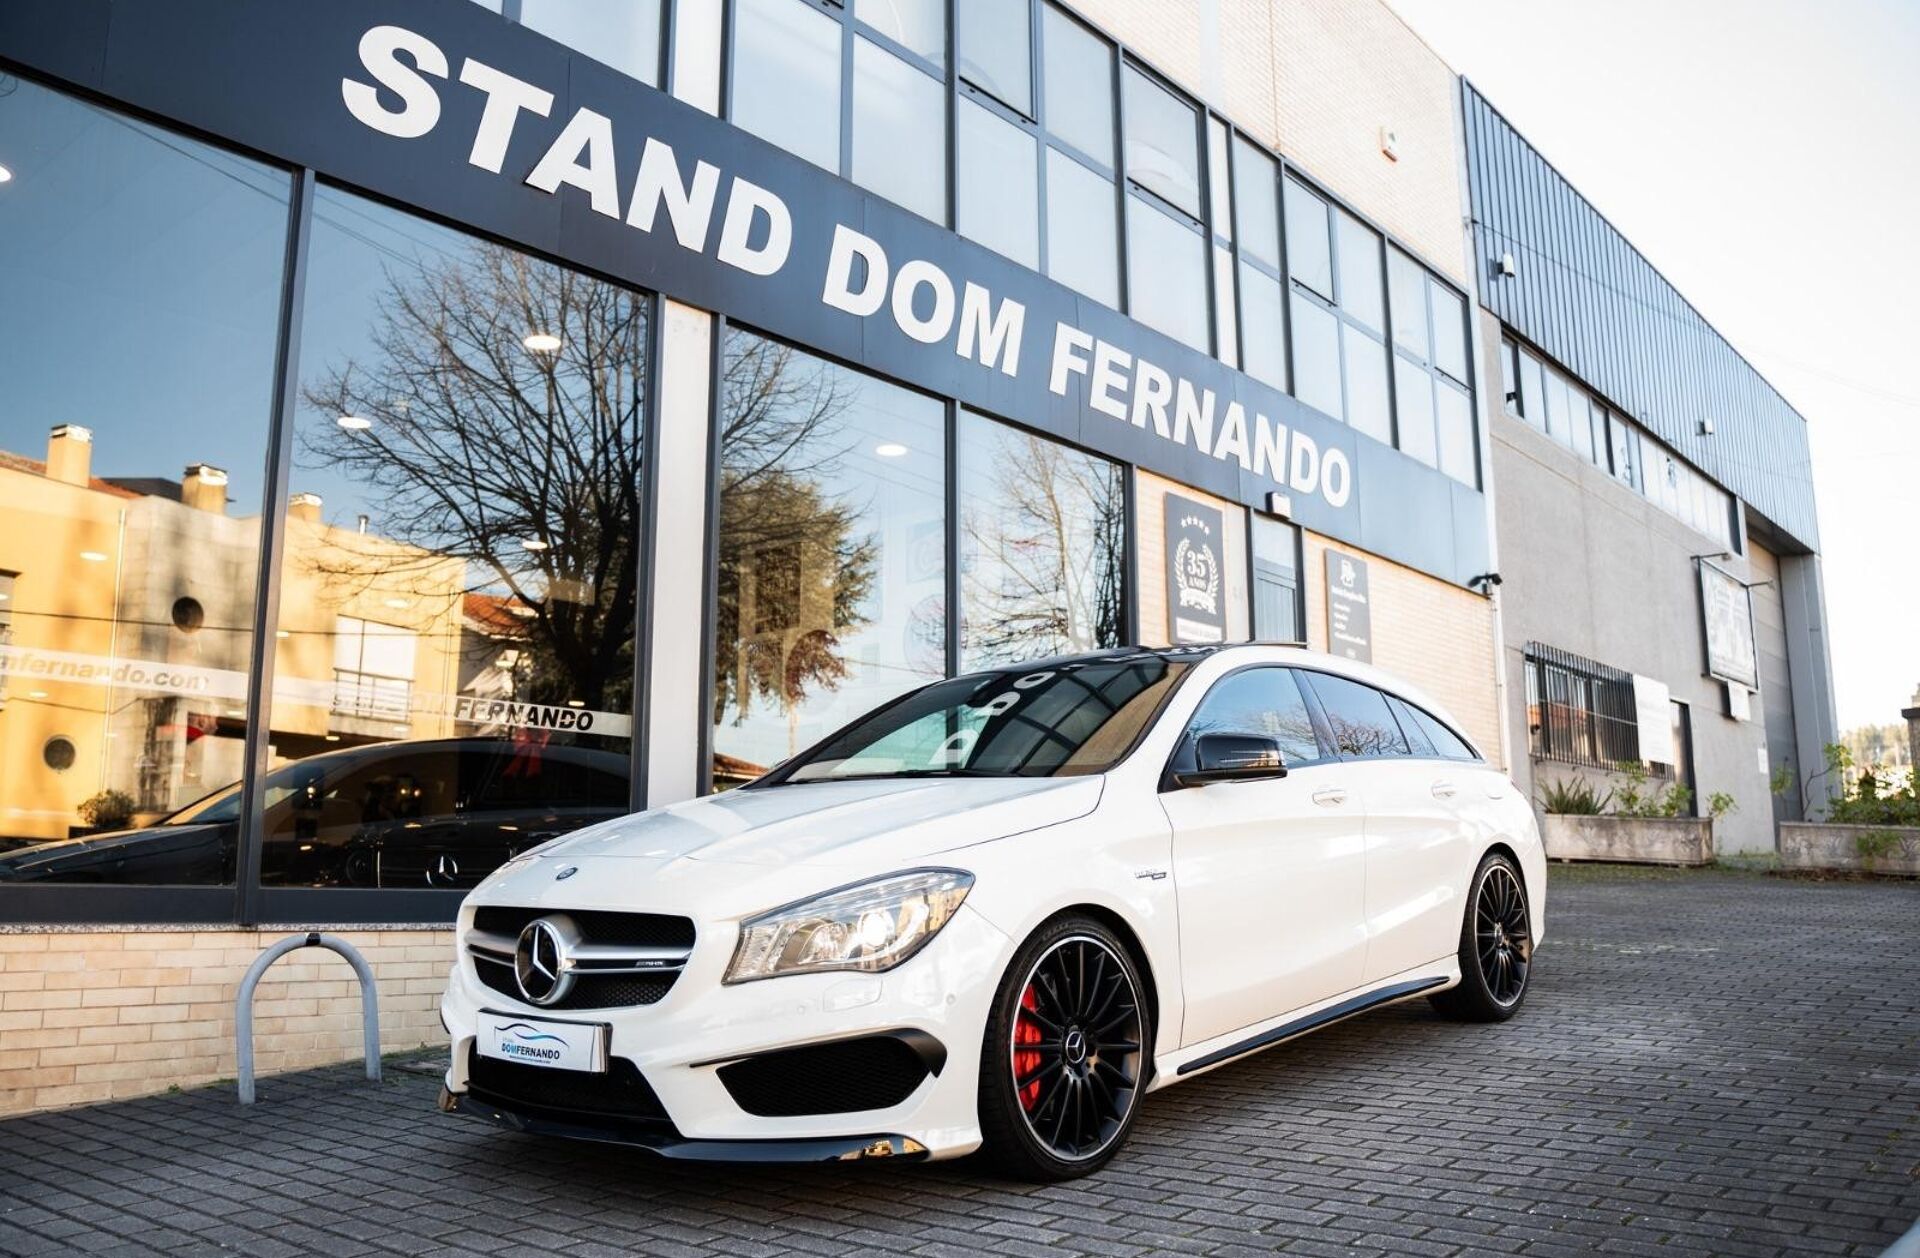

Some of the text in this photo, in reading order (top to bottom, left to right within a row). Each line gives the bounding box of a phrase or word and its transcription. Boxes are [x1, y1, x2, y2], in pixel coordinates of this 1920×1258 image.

[342, 25, 1350, 508] STAND DOM FERNANDO
[1187, 550, 1207, 577] 35
[455, 698, 593, 730] FERNANDO
